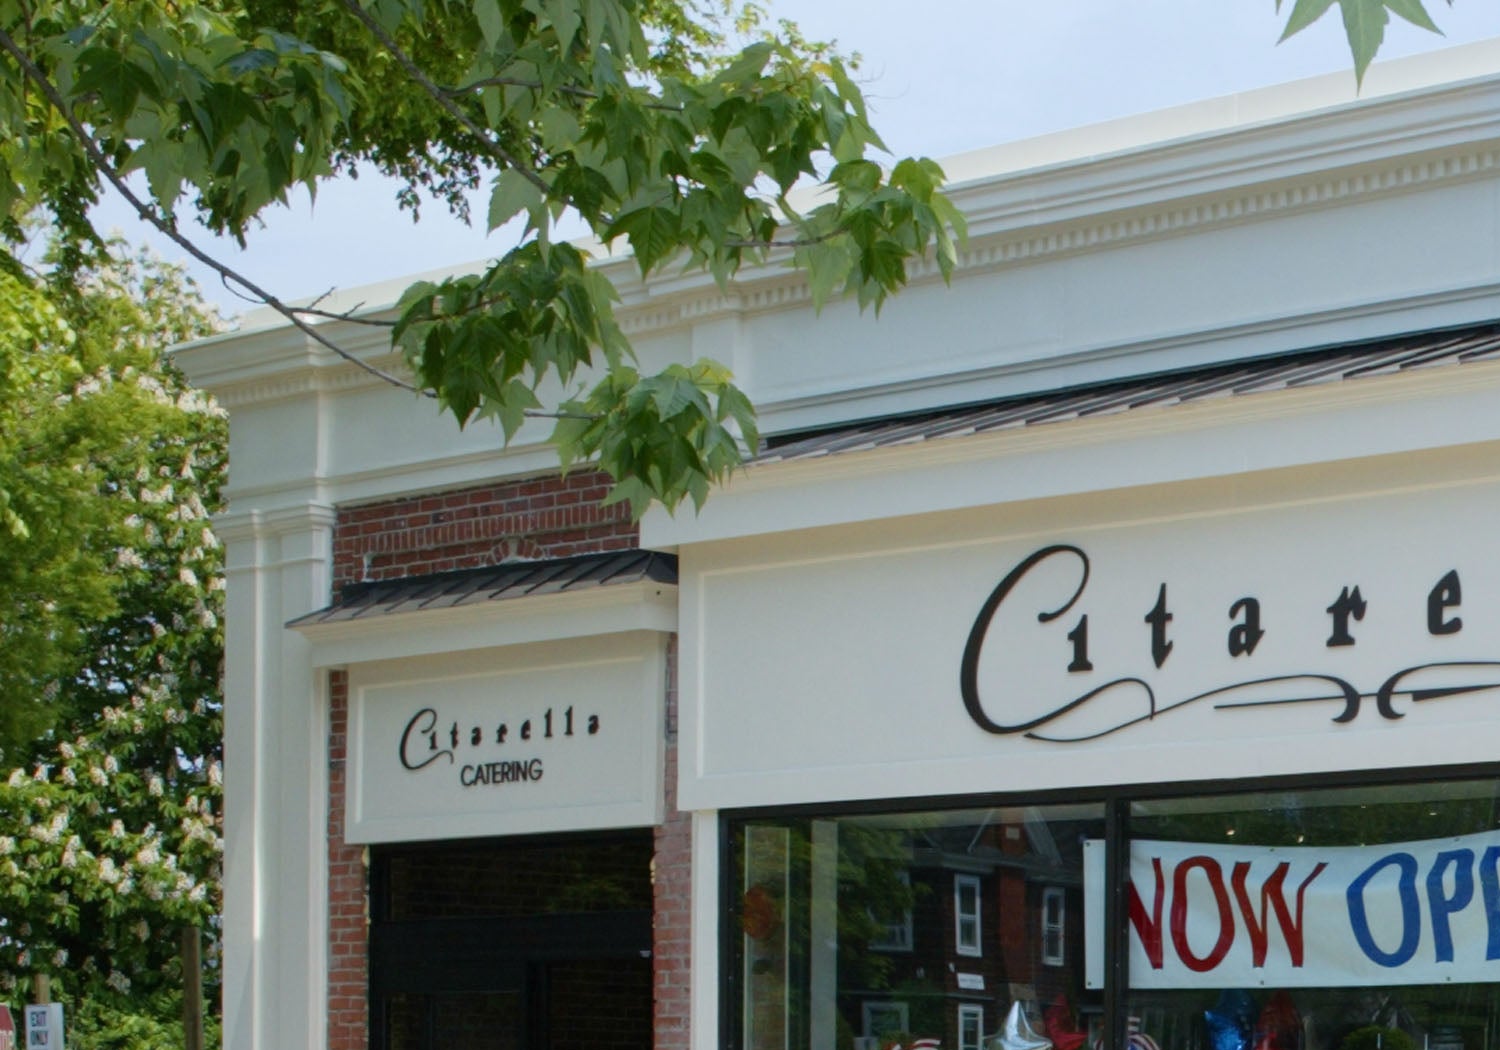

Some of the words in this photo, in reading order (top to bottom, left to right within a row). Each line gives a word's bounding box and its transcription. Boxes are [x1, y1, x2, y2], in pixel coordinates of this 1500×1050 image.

[399, 706, 600, 770] Citarella
[460, 758, 544, 787] CATERING
[1129, 855, 1329, 973] NOW
[30, 1010, 47, 1027] EXIT
[30, 1030, 49, 1046] ONLY
